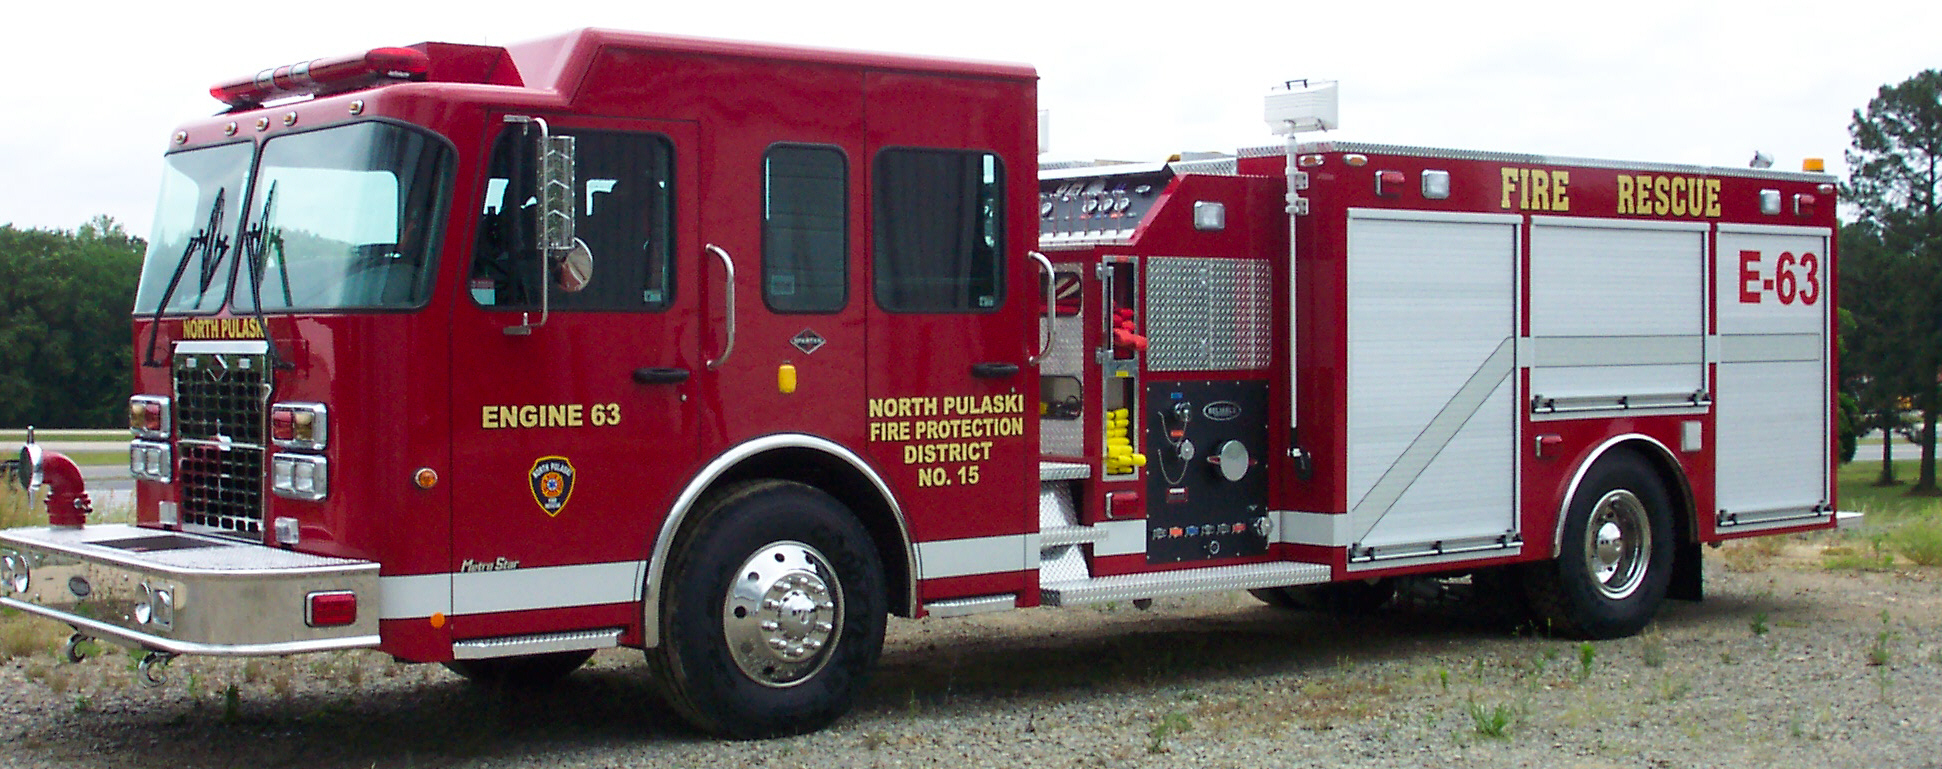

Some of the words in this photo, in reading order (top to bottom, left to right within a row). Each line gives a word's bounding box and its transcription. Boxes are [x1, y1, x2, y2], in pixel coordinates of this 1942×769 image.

[1500, 166, 1570, 212] FIRE
[1616, 174, 1722, 217] RESCUE
[1739, 250, 1820, 306] E-63
[183, 318, 219, 338] NORTH
[482, 404, 584, 429] ENGINE
[590, 402, 621, 427] 63
[868, 397, 937, 418] NORTH
[943, 394, 1024, 415] PULASKI
[870, 421, 911, 442] FIRE
[915, 417, 1023, 440] PROTECTION
[904, 441, 993, 465] DISTRICT
[918, 467, 951, 487] NO.
[957, 465, 980, 485] 15
[494, 555, 520, 571] Star
